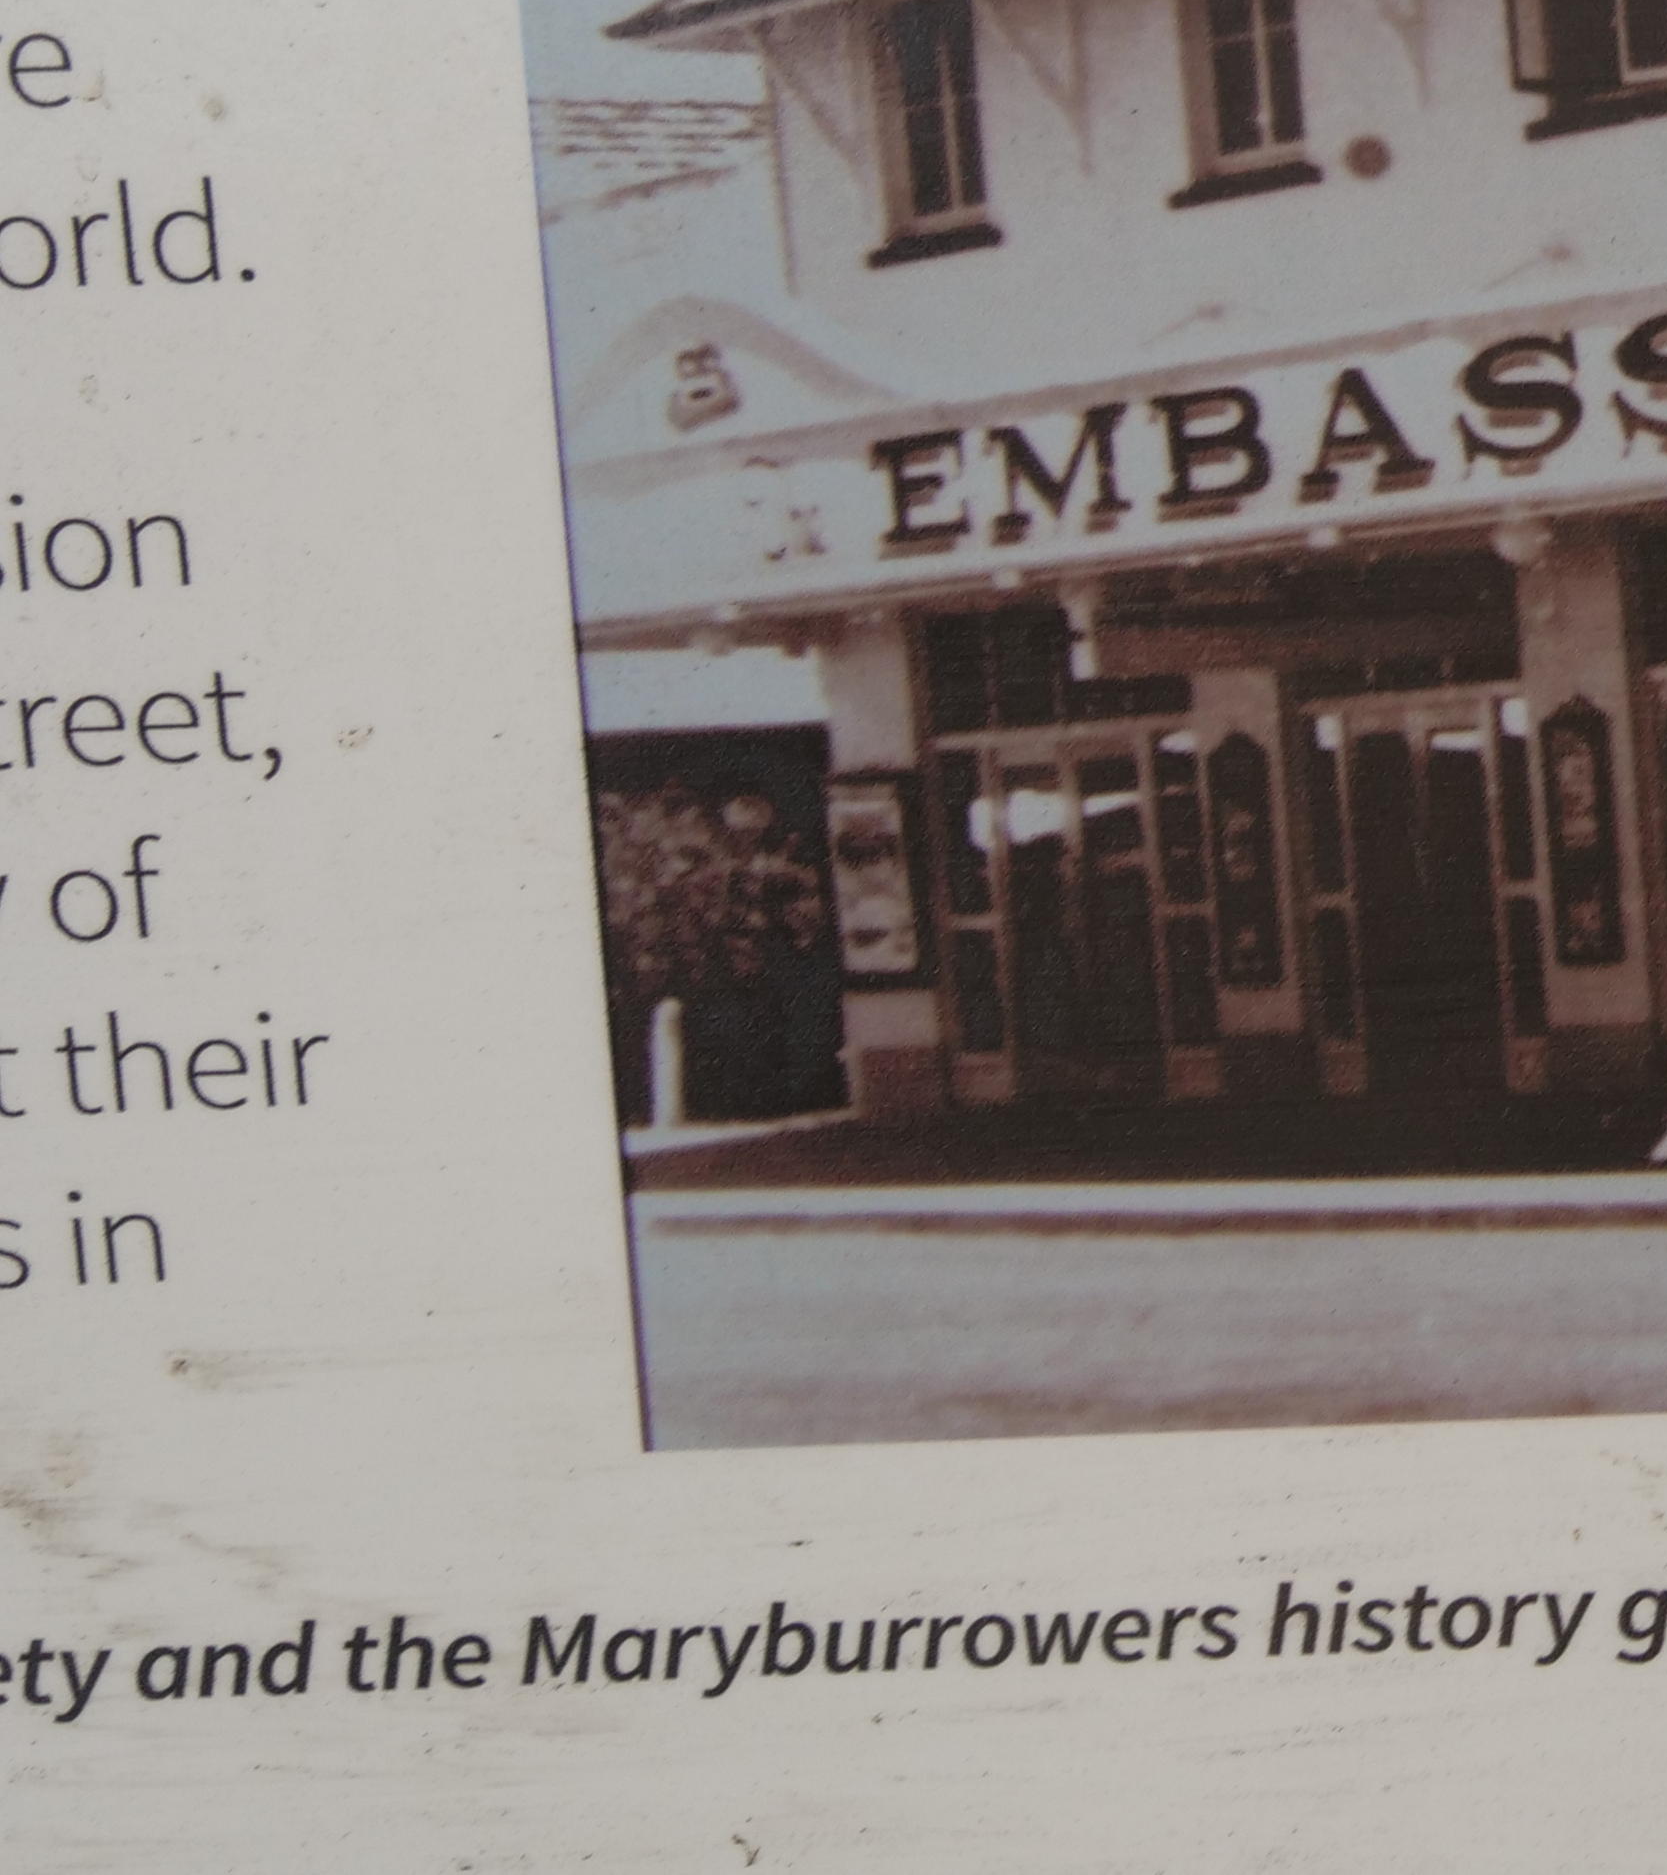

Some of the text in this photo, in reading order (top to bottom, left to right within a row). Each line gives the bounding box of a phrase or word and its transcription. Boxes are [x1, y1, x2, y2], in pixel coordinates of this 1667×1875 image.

[0, 493, 192, 593] ion
[0, 670, 283, 782] reet,
[48, 832, 162, 944] of
[54, 1009, 331, 1117] their
[66, 1189, 166, 1286] in
[0, 1637, 113, 1725] ty
[134, 1618, 318, 1702] and
[341, 1614, 493, 1695] the
[520, 1600, 1240, 1700] Maryburrowers
[1266, 1578, 1597, 1667] history
